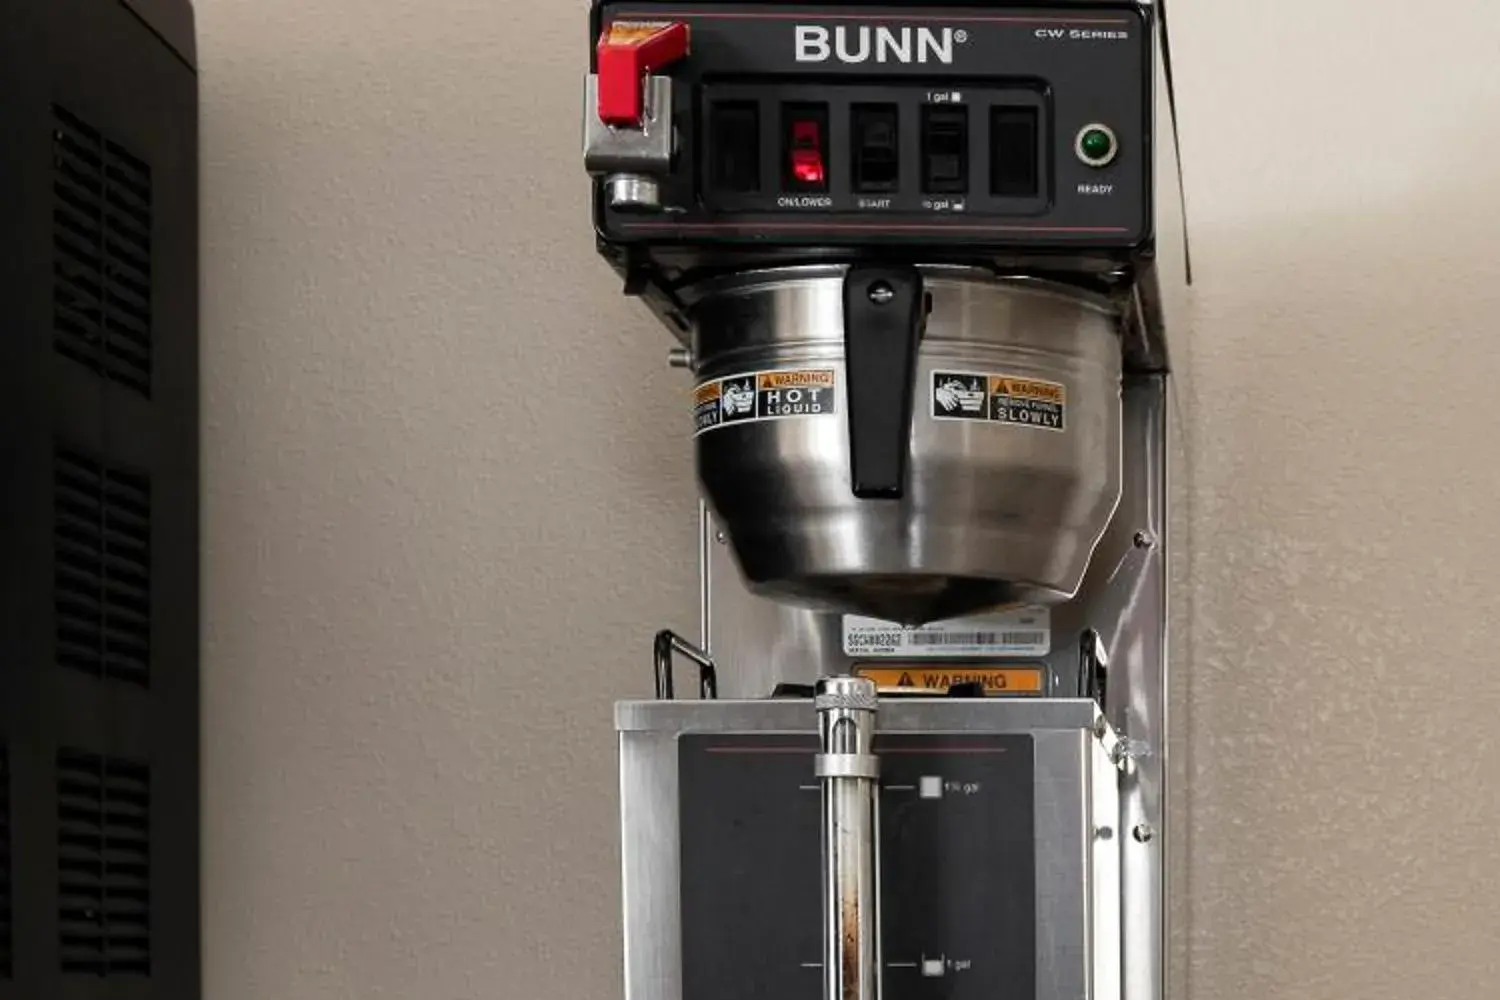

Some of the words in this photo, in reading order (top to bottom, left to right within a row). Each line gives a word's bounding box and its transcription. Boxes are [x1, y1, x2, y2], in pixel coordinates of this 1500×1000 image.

[1034, 28, 1063, 39] CW
[1069, 29, 1129, 40] SERIES
[1077, 183, 1113, 193] READY
[775, 373, 829, 386] WARNING
[767, 388, 821, 404] HOT
[767, 403, 822, 415] LIQUID
[997, 407, 1059, 426] SLOWLY
